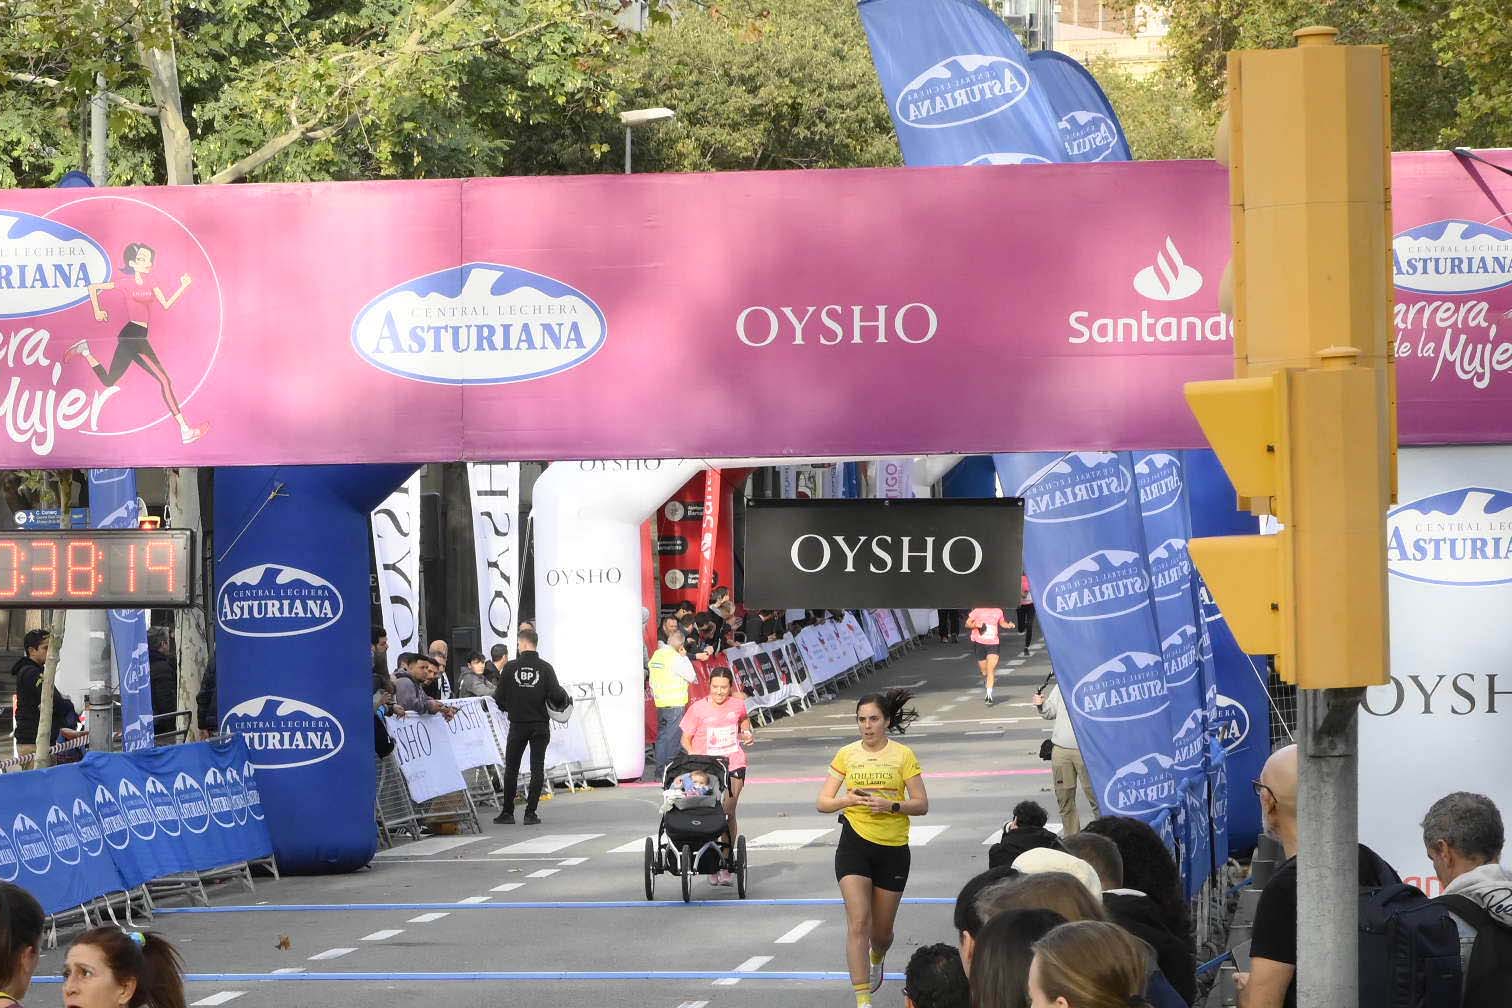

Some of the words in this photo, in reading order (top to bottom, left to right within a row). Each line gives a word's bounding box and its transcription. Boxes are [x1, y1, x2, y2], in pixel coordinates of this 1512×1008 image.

[14, 246, 87, 257] LECHERA
[1408, 246, 1461, 255] CENTRAL
[1464, 245, 1512, 253] LECHER
[409, 305, 488, 317] CENTRAL
[497, 304, 579, 316] LECHERA
[1393, 299, 1490, 330] arrera
[372, 309, 587, 354] ASTURIANA
[736, 304, 938, 346] OYSHO
[1068, 311, 1236, 344] Santand
[1417, 336, 1435, 358] la
[1430, 324, 1512, 389] Muje
[1415, 521, 1481, 533] CENTRAL
[790, 534, 983, 575] OYSHO
[546, 568, 622, 586] OYSHO
[233, 589, 276, 598] CENTRAL
[280, 589, 329, 597] LECHERA
[220, 594, 333, 621] ASTURIANA
[520, 671, 534, 680] BP
[1361, 673, 1512, 716] OYSH
[235, 721, 277, 730] CENTRAL
[282, 720, 330, 729] LECHERA
[243, 731, 335, 751] TURIANA
[850, 772, 893, 780] ATHLETICS
